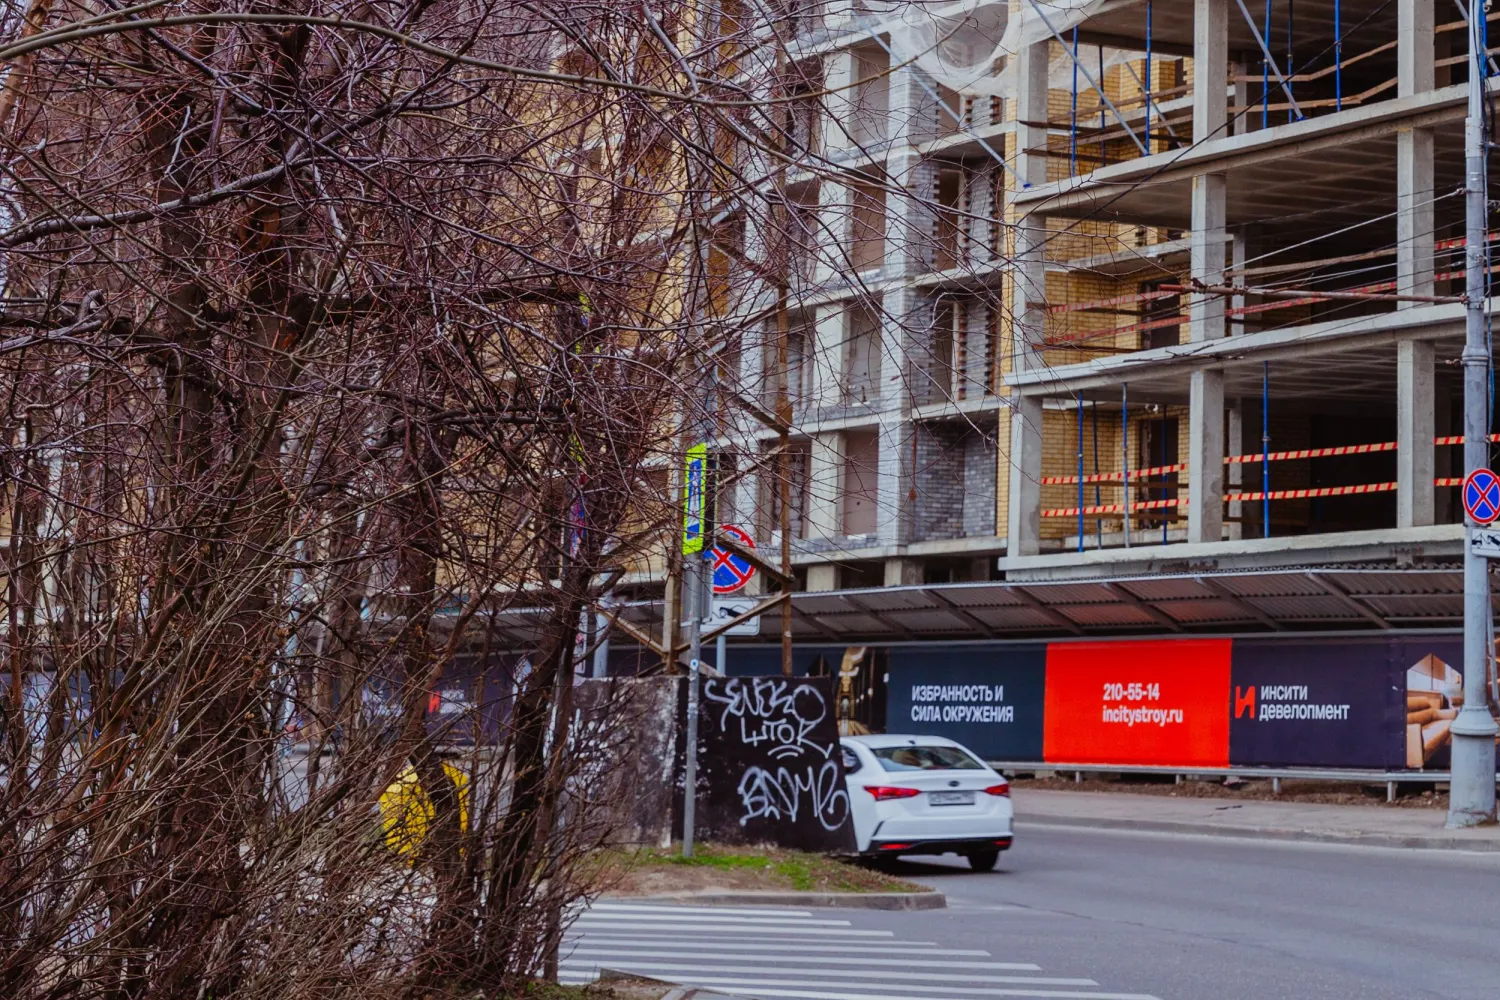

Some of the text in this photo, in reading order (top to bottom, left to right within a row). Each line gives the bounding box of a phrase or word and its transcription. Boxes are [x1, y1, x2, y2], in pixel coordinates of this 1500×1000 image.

[911, 685, 1004, 702] ИЗБРАННОСТЬ И
[1103, 683, 1160, 701] 210-55-14
[911, 705, 1014, 723] СИЛА ОКРУЖЕНИЯ
[1102, 705, 1184, 727] incitystroy.ru
[1259, 703, 1350, 721] девелопмент
